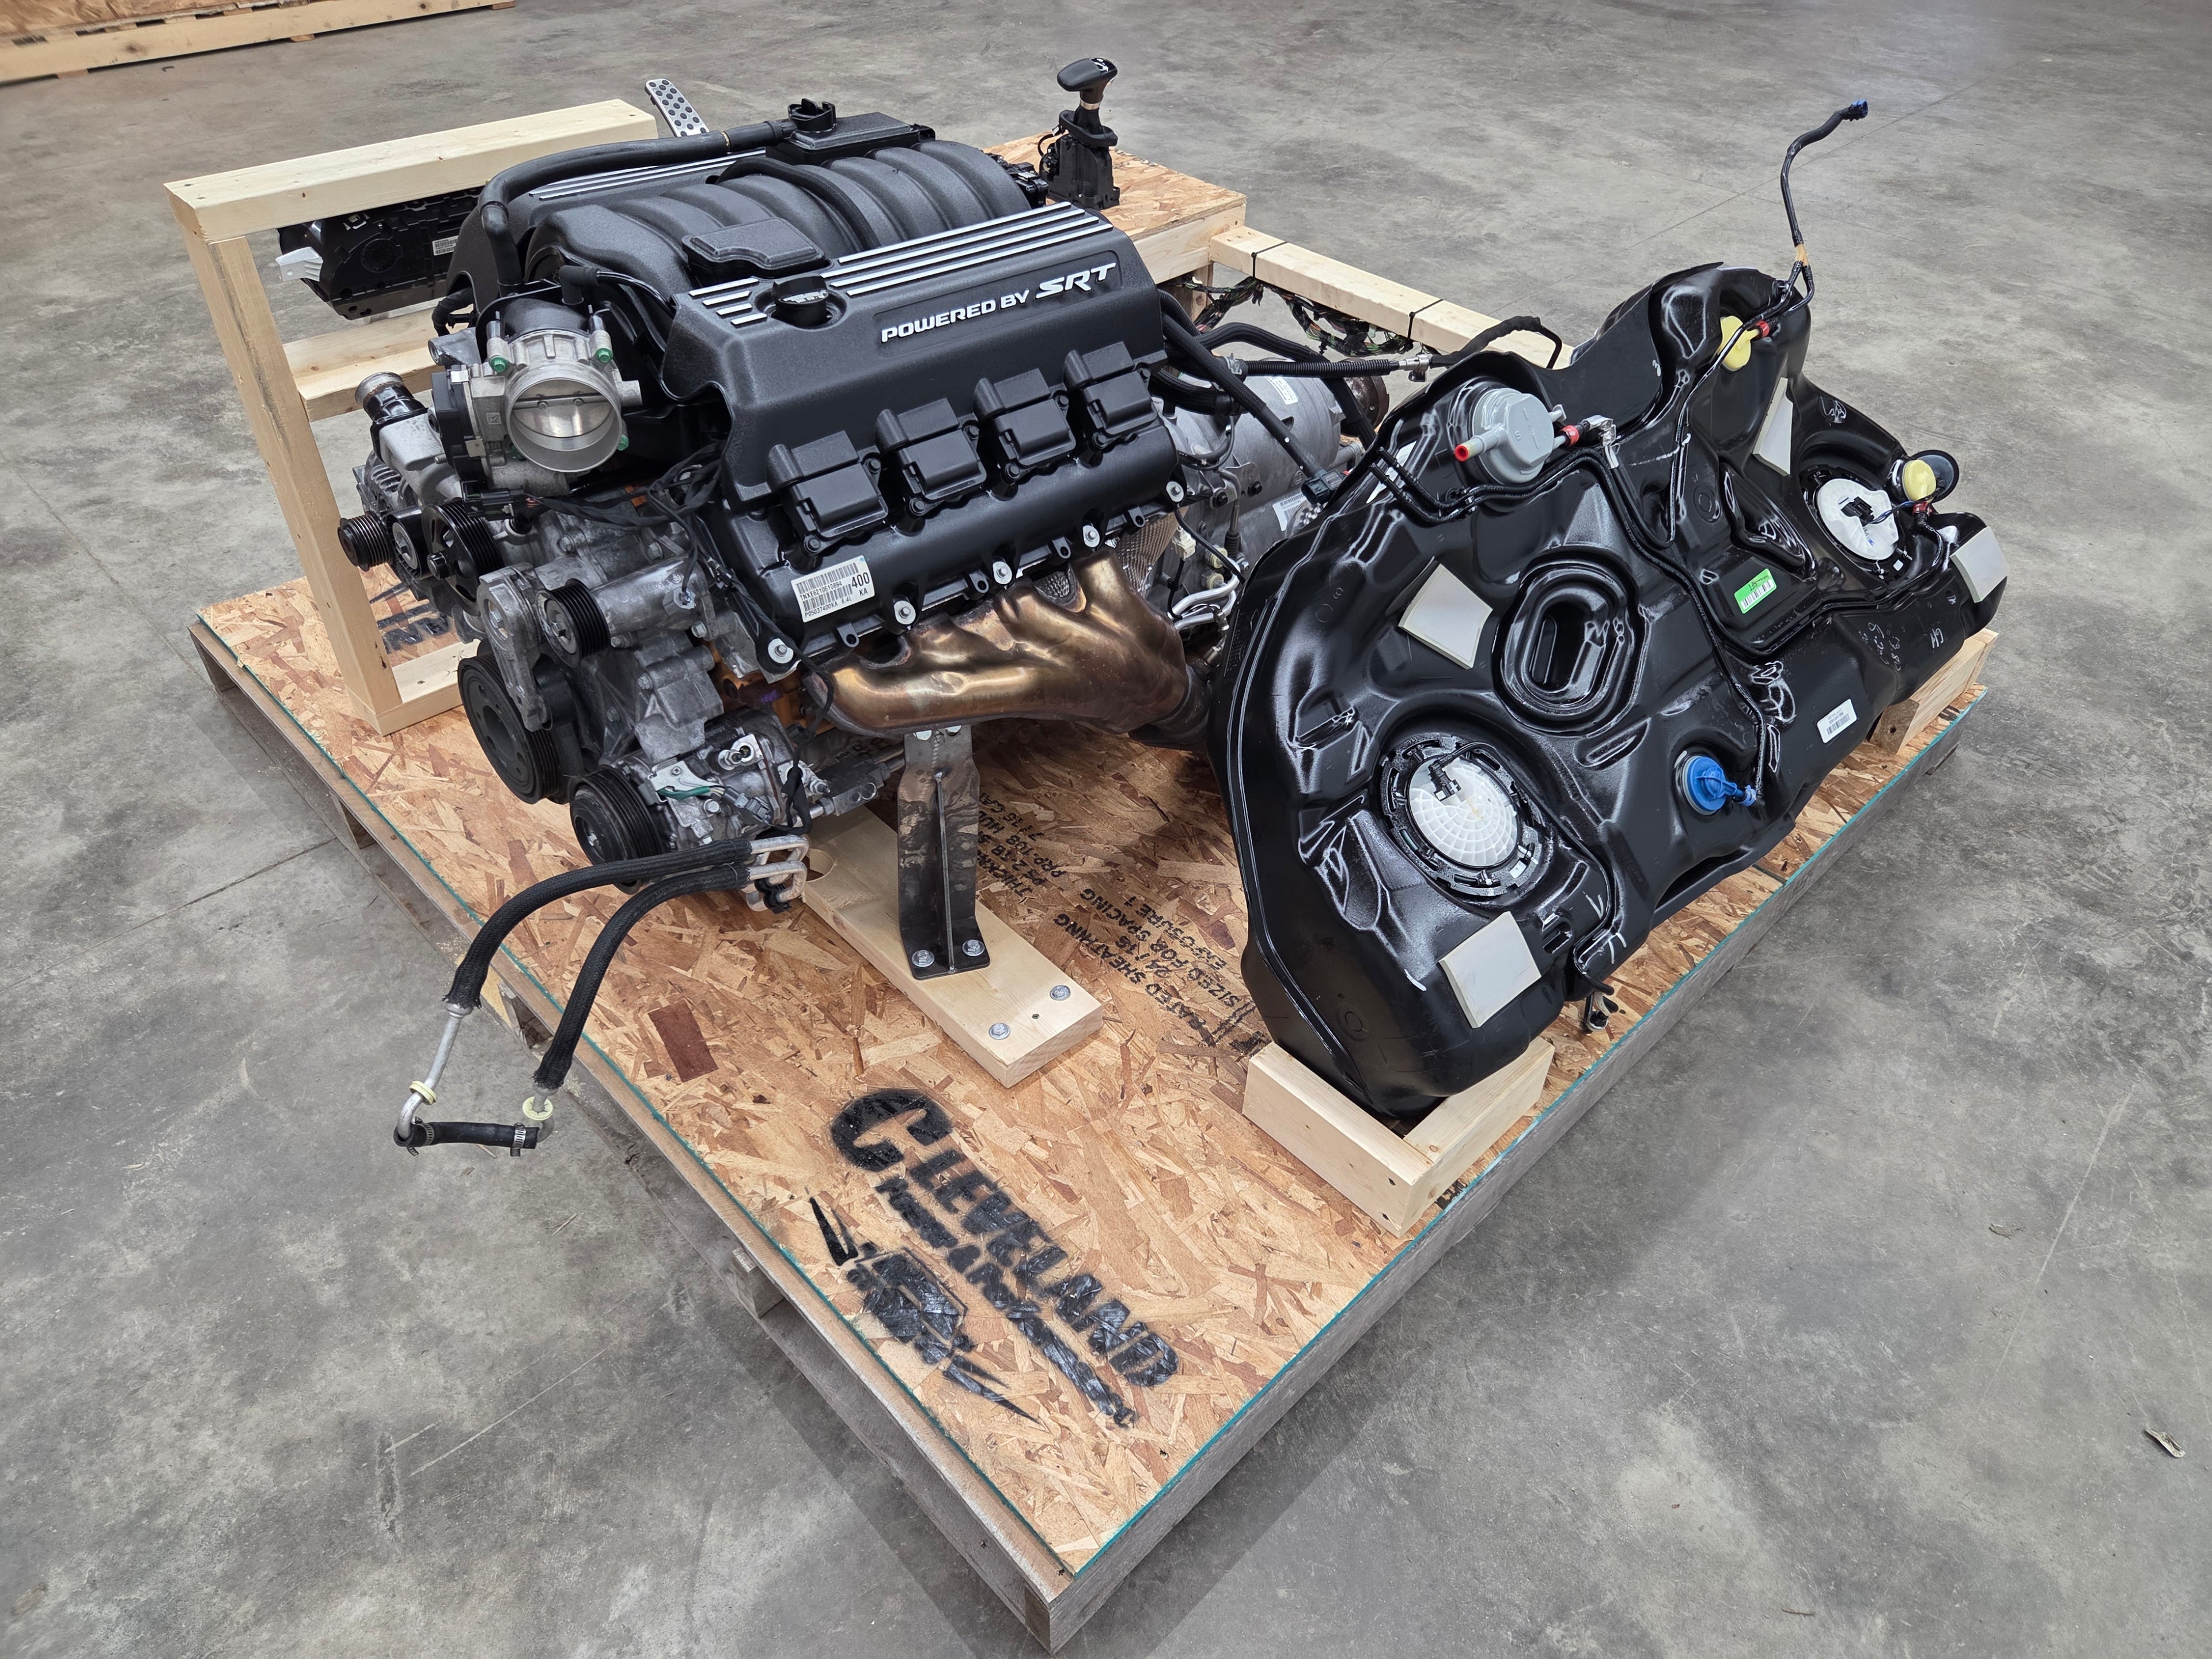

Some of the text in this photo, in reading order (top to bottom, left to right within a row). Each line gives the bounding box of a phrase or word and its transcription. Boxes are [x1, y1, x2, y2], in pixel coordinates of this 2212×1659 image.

[881, 262, 1116, 343] POWERED BY SRT
[851, 572, 870, 588] 400
[859, 589, 868, 597] KA
[1053, 913, 1207, 1030] RATED SHEATHING
[1080, 888, 1241, 1007] SIZED FOR SPACING
[1135, 903, 1228, 971] EXPOSURE
[830, 1088, 1180, 1388] CLEVELAND
